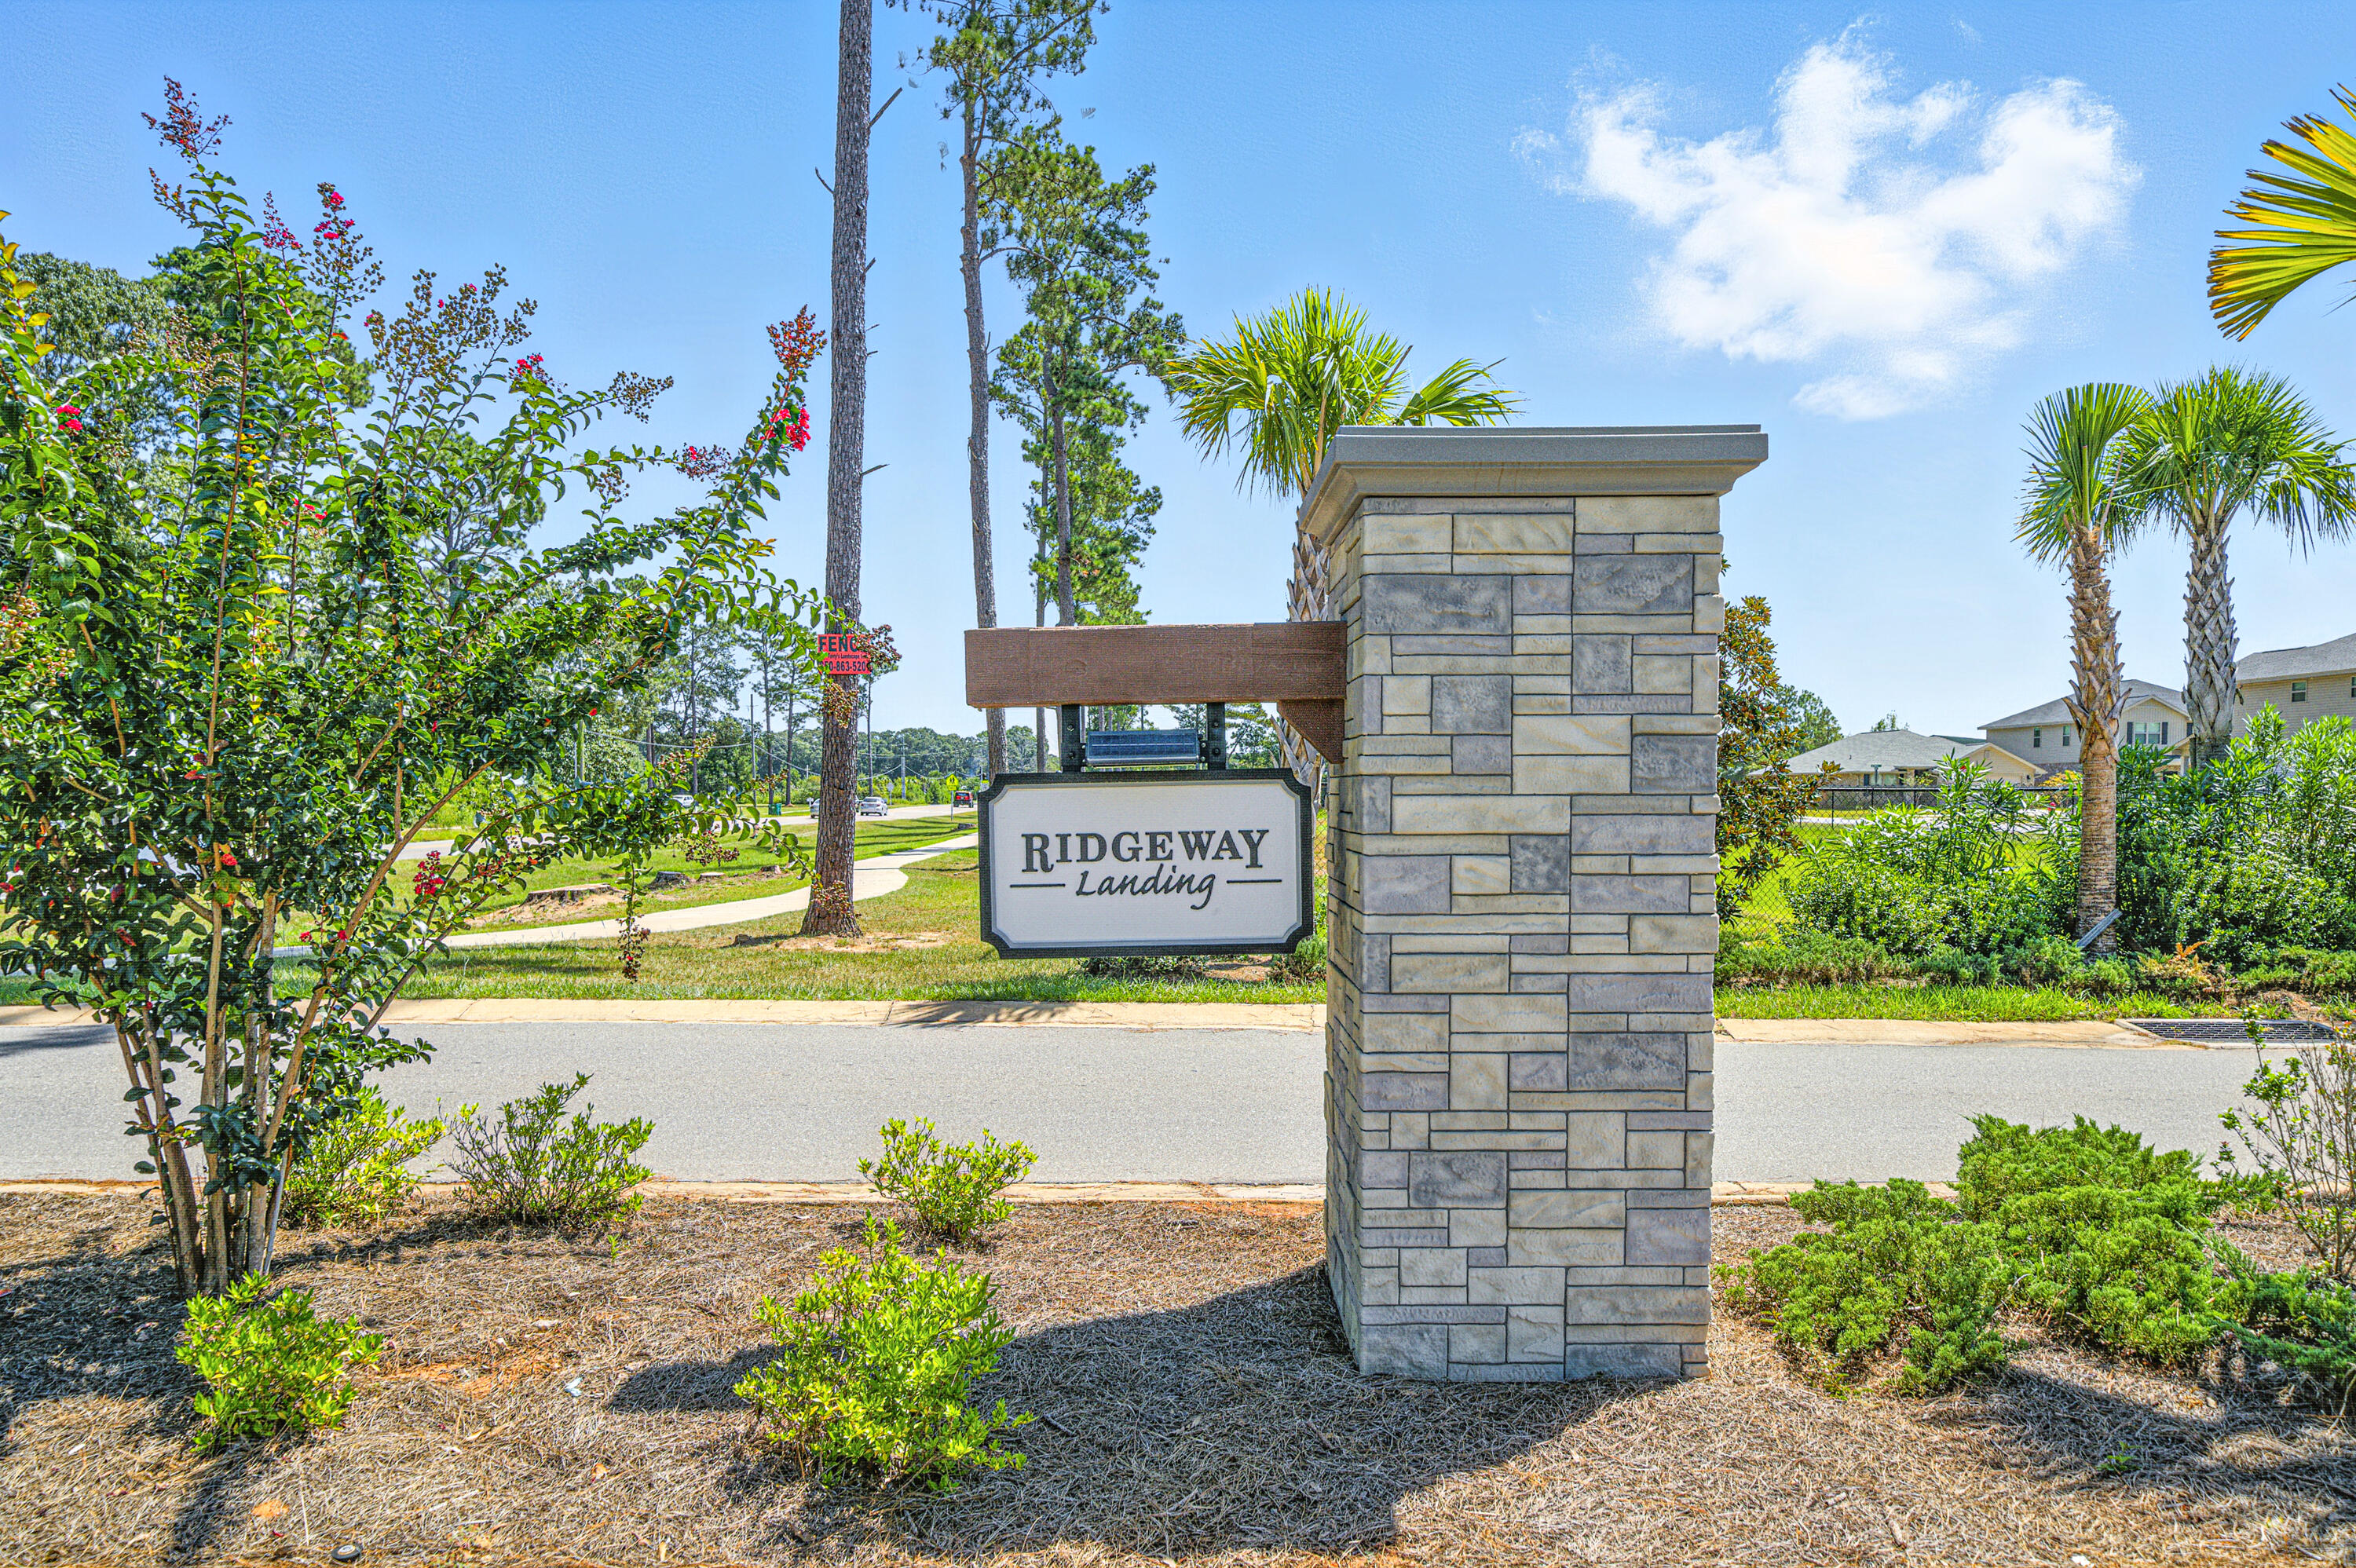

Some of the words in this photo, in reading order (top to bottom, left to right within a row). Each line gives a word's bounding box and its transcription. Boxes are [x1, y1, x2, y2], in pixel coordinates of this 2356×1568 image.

[818, 636, 867, 652] FENC
[1022, 830, 1269, 872] RIDGEWAY
[1075, 863, 1216, 910] Landing
